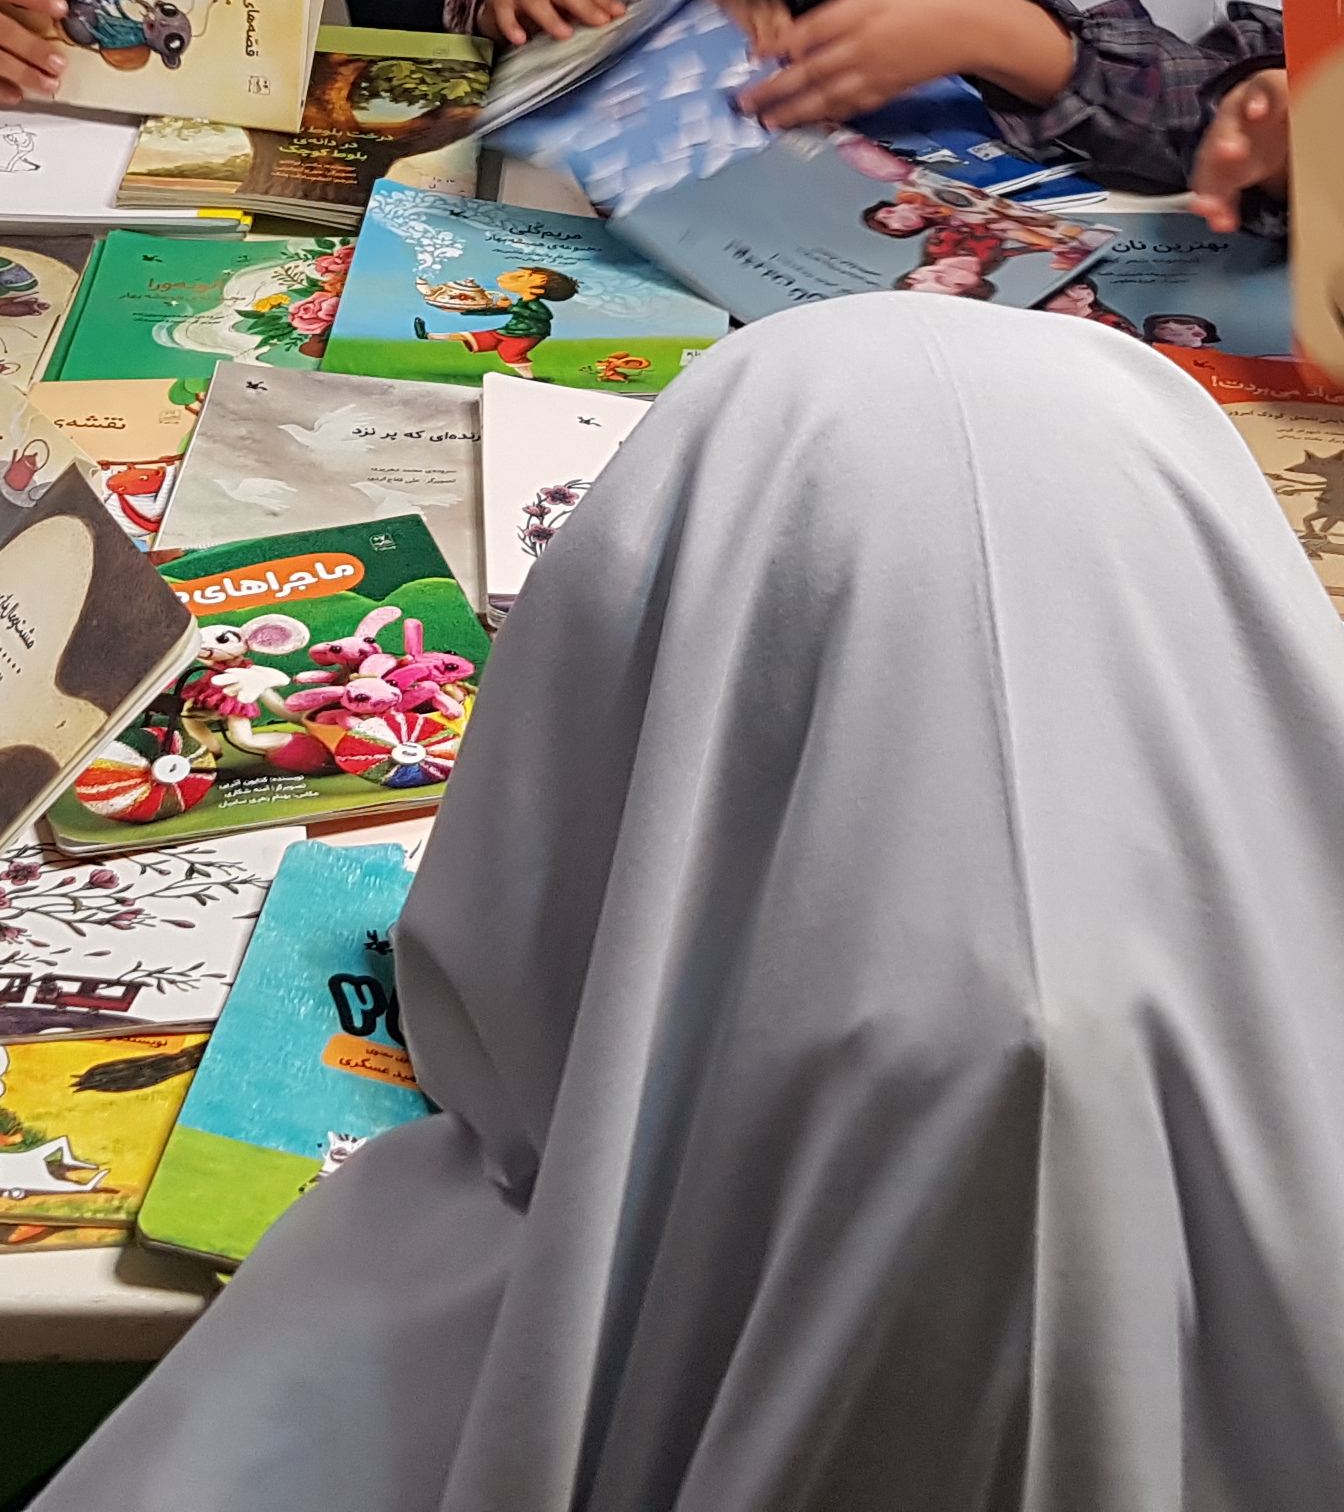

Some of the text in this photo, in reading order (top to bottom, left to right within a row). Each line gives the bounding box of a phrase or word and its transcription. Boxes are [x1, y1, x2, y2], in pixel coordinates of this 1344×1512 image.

[1112, 239, 1147, 253] نان
[351, 427, 482, 442] رنده‌ای که پر نزد
[193, 561, 355, 604] ماجراهای
